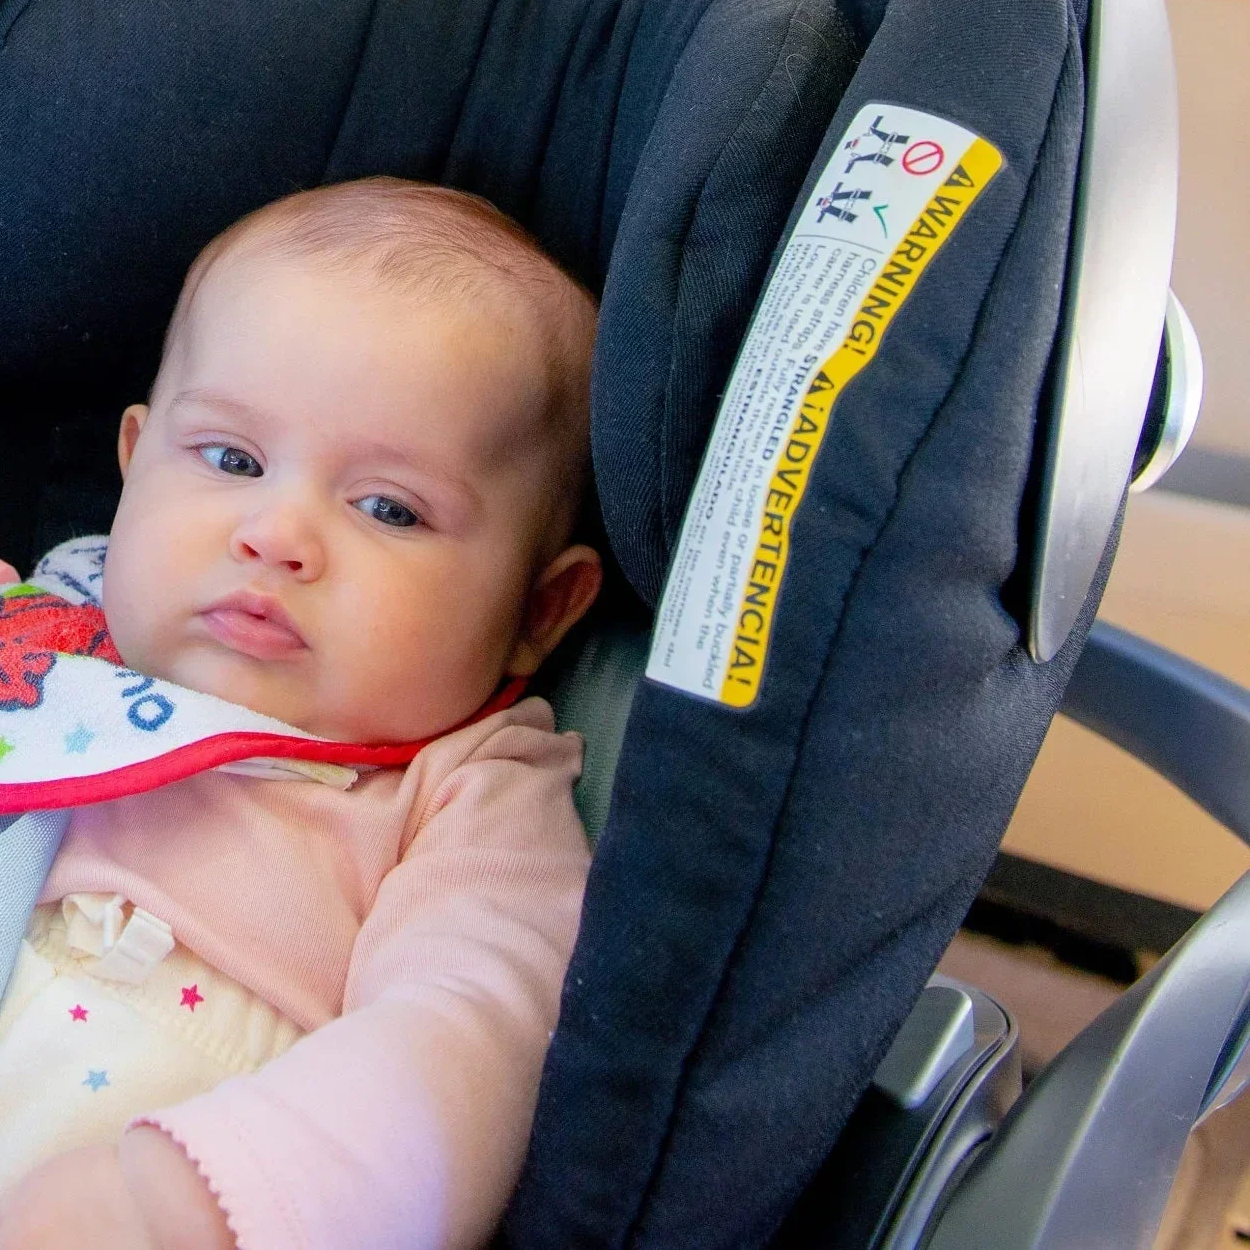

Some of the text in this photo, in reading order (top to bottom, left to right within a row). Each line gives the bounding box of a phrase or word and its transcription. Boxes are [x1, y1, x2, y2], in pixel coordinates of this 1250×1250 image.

[811, 247, 842, 290] carrier
[818, 251, 861, 306] harness
[833, 256, 878, 318] Children
[801, 293, 816, 305] is
[780, 308, 804, 345] used
[790, 308, 825, 352] straps.
[813, 320, 843, 353] have
[757, 347, 783, 403] outside
[771, 357, 797, 393] Fully
[749, 396, 777, 454] restrain
[761, 353, 819, 461] STRANGLED
[725, 193, 962, 688] WARNING! ¡ADVERTENCIA!
[740, 458, 754, 483] the
[753, 464, 767, 480] in
[725, 487, 745, 527] child
[741, 483, 762, 529] loose
[737, 532, 748, 550] or
[701, 622, 729, 691] buckled
